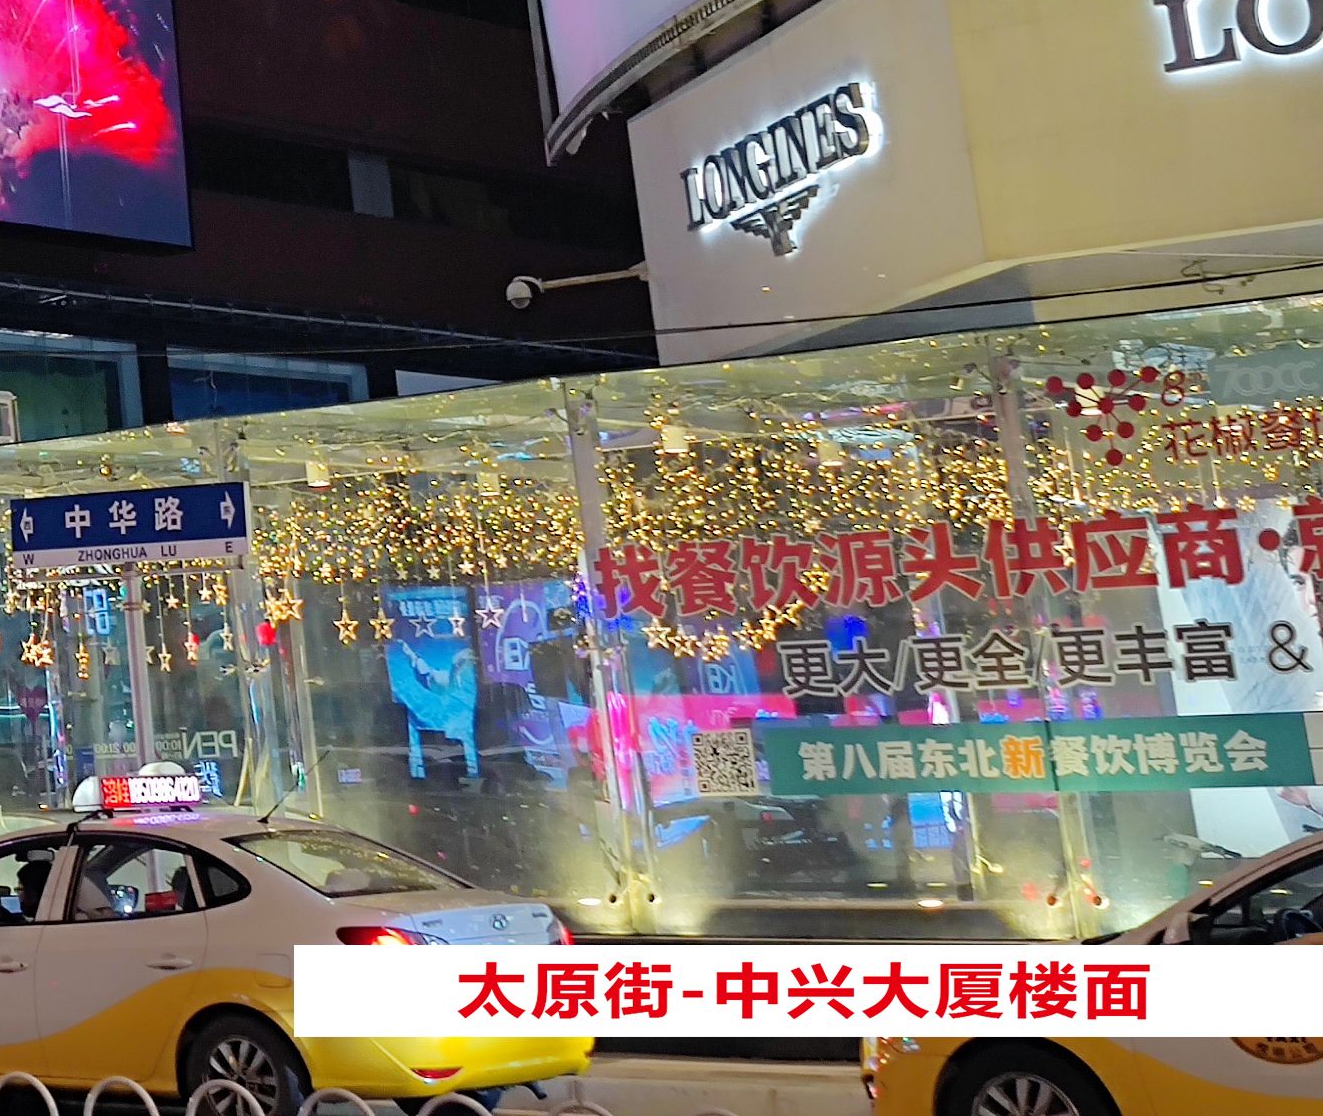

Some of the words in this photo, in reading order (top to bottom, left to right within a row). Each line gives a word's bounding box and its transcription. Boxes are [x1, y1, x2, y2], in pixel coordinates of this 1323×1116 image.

[680, 82, 870, 231] LONGINES
[64, 495, 184, 539] 中华路
[23, 554, 35, 565] W
[77, 549, 147, 562] ZHONGHUA
[160, 545, 177, 557] LU
[224, 541, 233, 553] E
[1266, 620, 1314, 673] &
[798, 730, 1270, 782] 第八届东北新餐饮博览会
